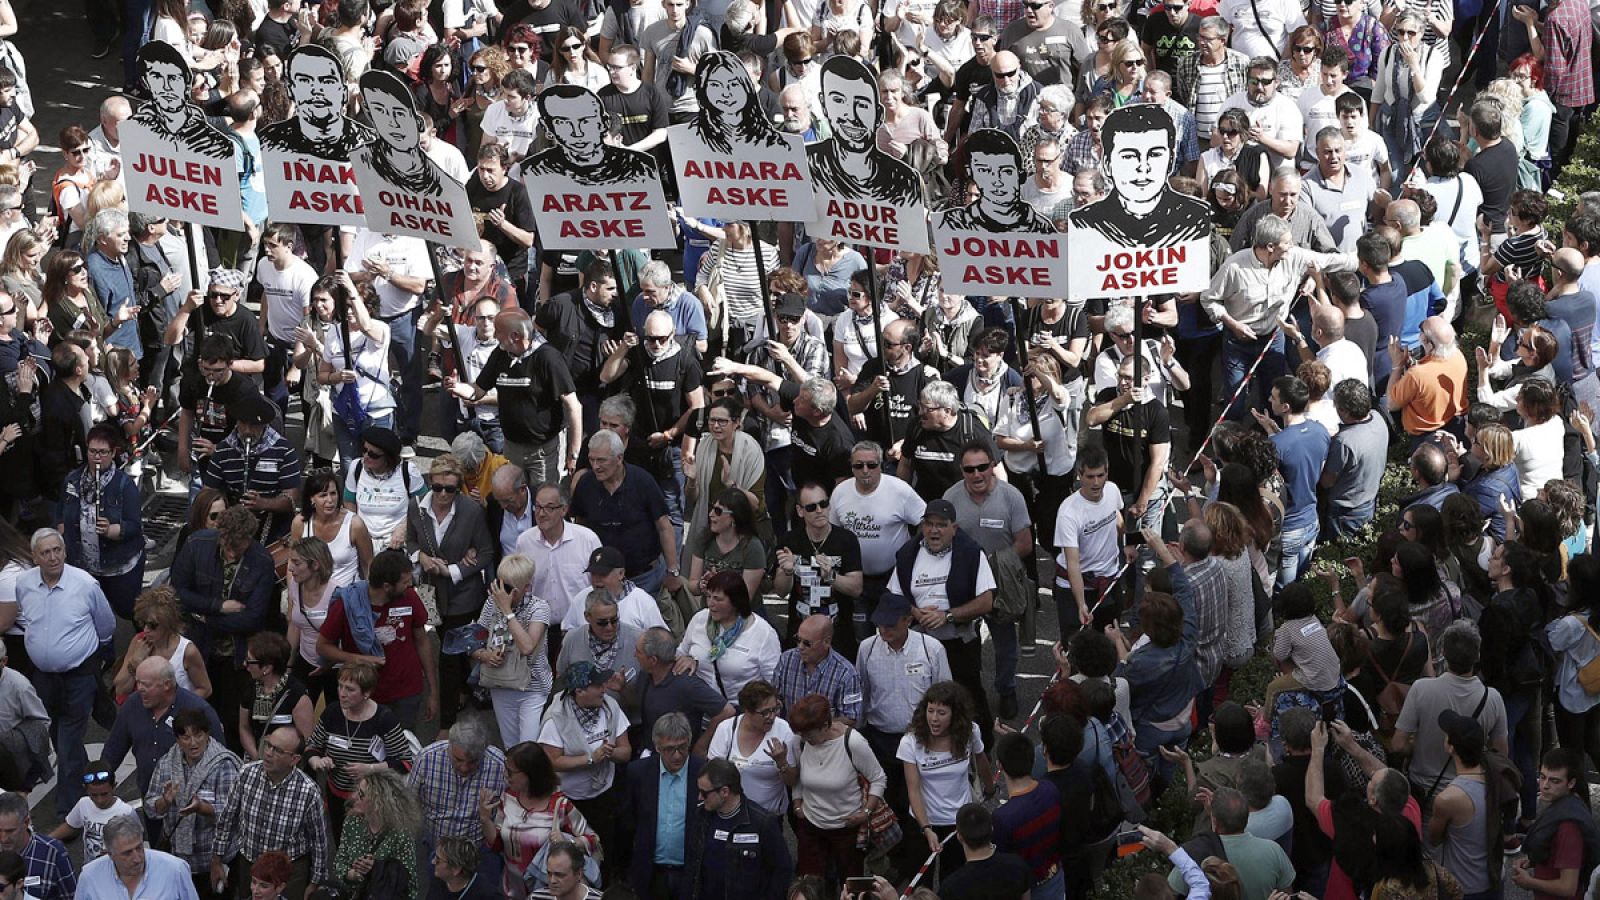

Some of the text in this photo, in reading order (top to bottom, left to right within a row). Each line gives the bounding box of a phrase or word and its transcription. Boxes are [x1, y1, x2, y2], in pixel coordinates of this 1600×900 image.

[133, 155, 222, 186] JULEN
[283, 158, 358, 186] IÑAK
[684, 160, 801, 180] AINARA
[146, 184, 217, 215] ASKE
[378, 190, 454, 218] OIHAN
[542, 192, 651, 212] ARATZ
[708, 187, 788, 207] ASKE
[390, 211, 453, 237] ASKE
[826, 200, 899, 225] ADUR
[560, 219, 646, 238] ASKE
[830, 220, 900, 246] ASKE
[944, 238, 1059, 259] JONAN
[1096, 246, 1187, 272] JOKIN
[962, 265, 1052, 287] ASKE
[1100, 267, 1179, 291] ASKE
